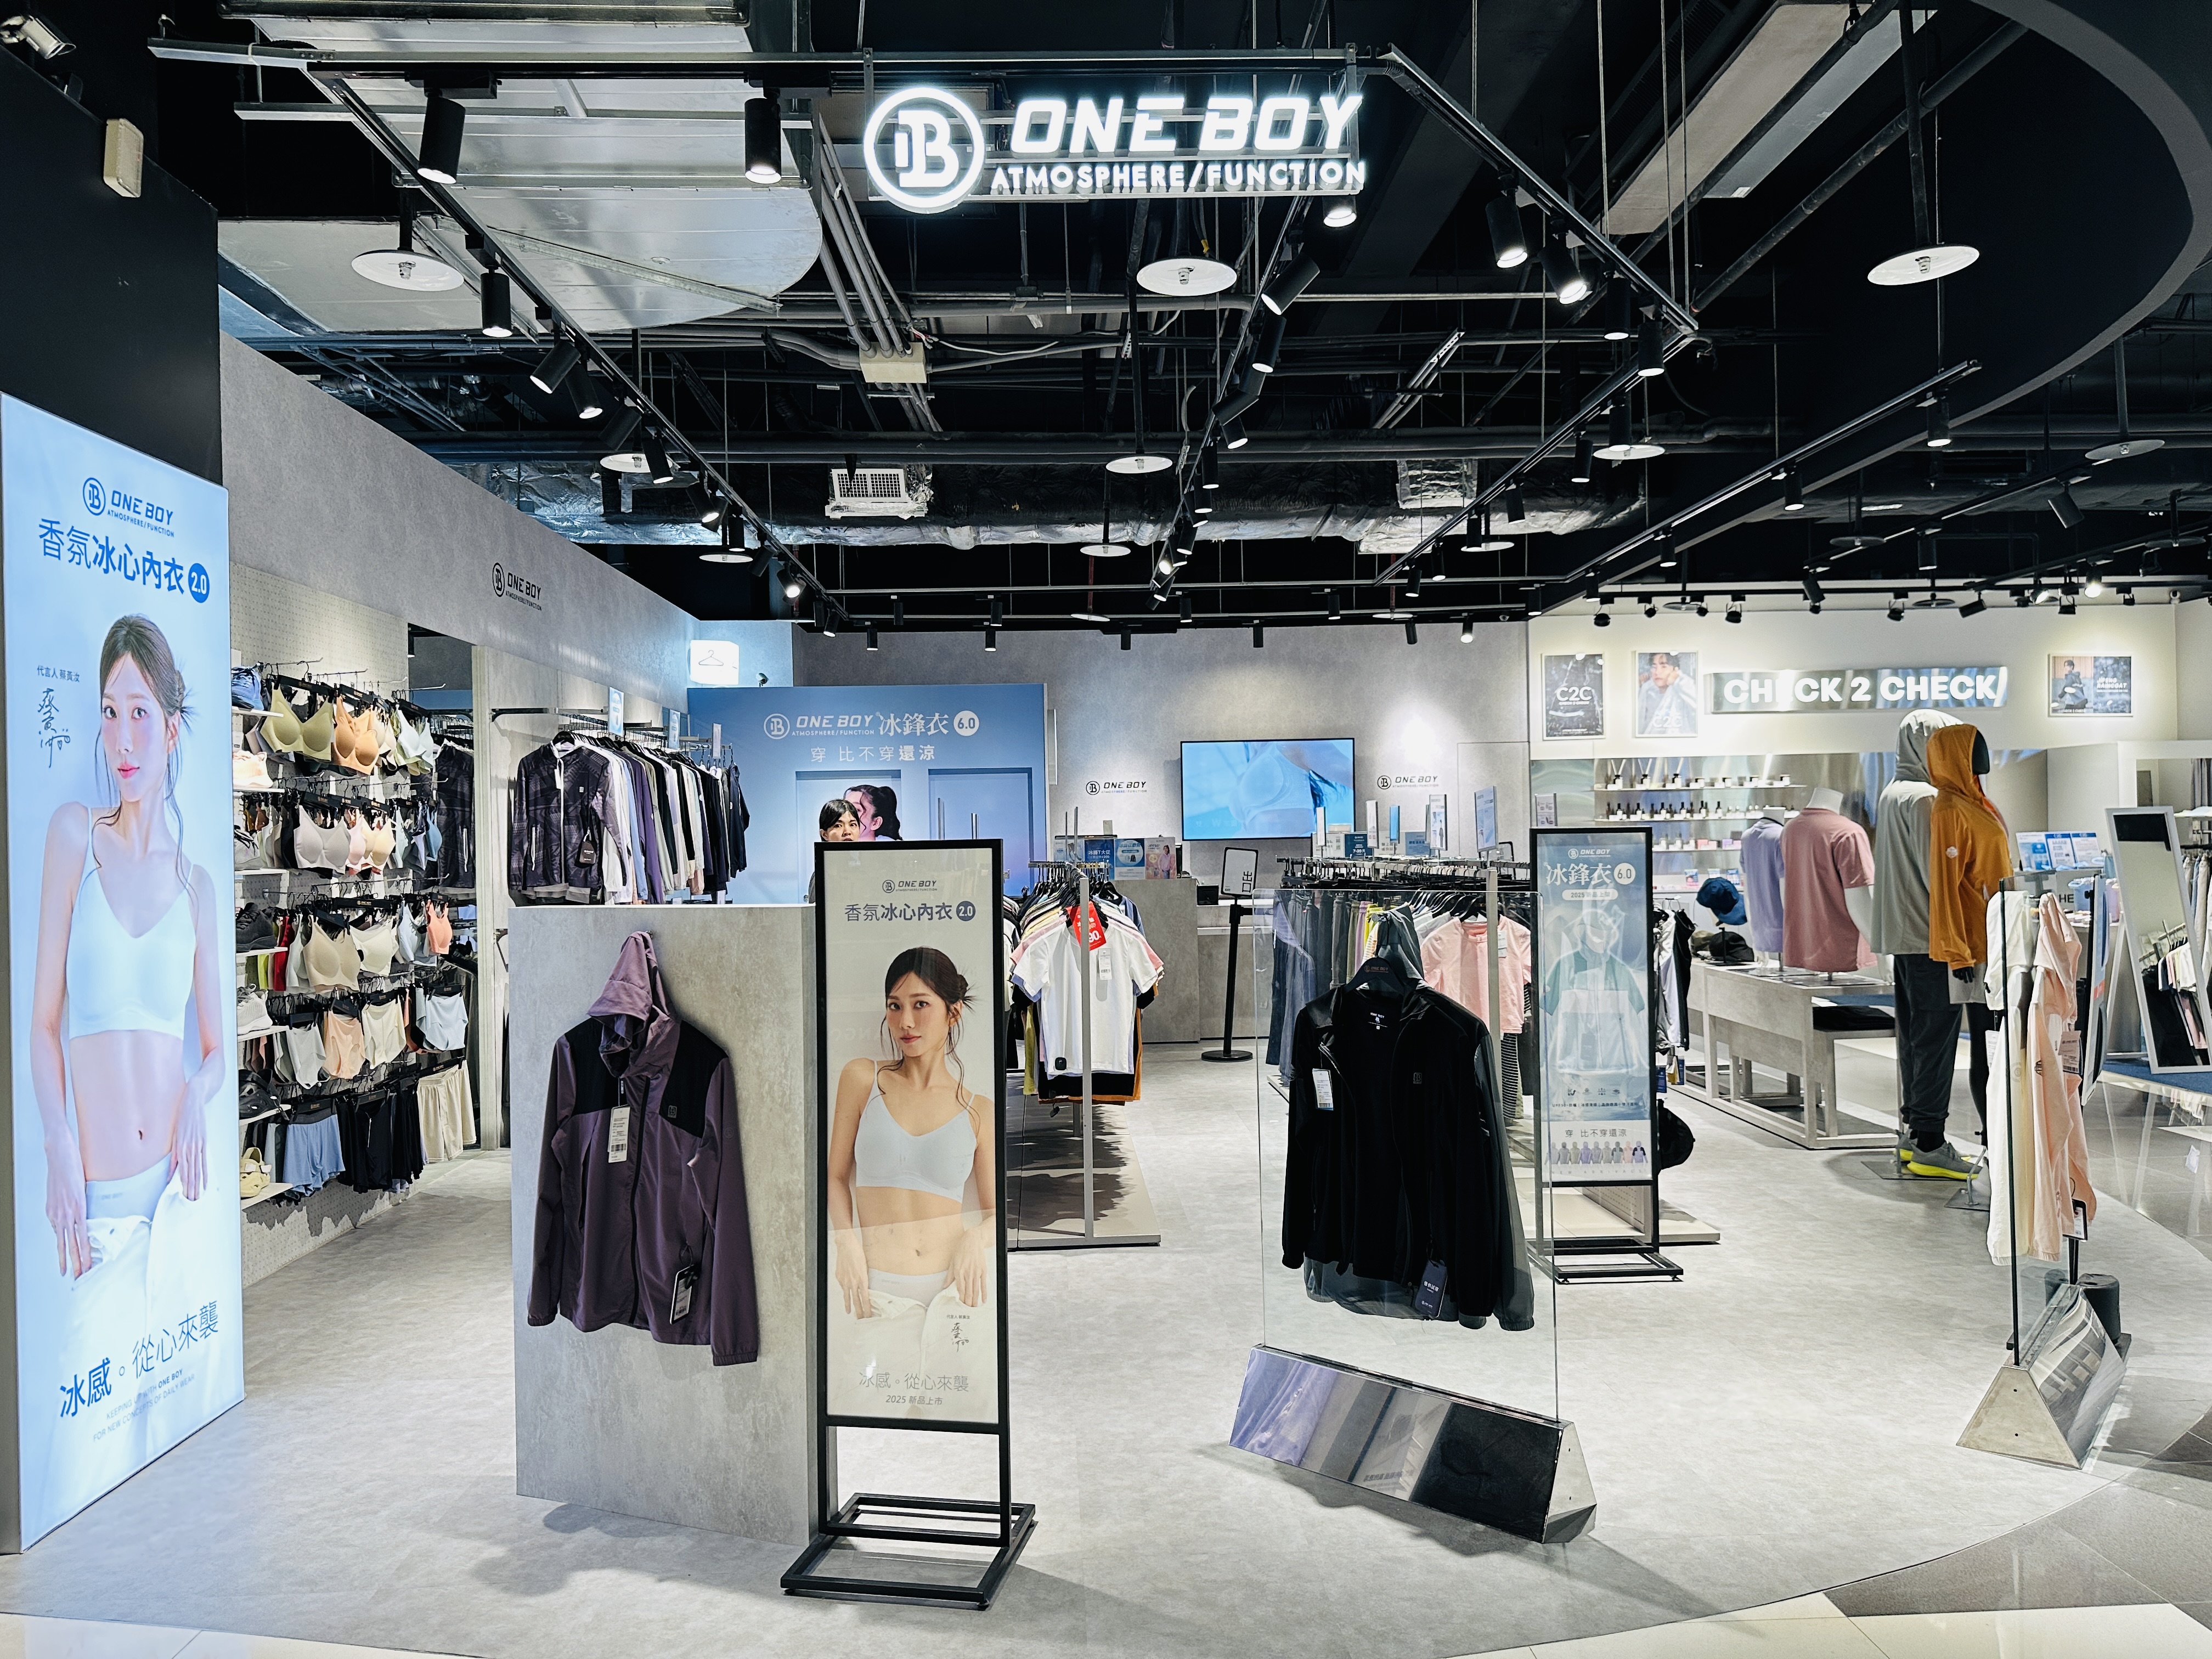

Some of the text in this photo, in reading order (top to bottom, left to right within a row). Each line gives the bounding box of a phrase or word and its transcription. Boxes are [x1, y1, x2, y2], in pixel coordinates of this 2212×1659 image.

[1011, 95, 1363, 154] ONE BOY
[990, 162, 1366, 189] ATMOSPHERE/FUNCTION
[111, 490, 173, 526] ONE BOY
[107, 509, 174, 538] ATMOSPHERE/FUNCTION
[38, 518, 207, 595] 香氛冰心內衣 2.0
[507, 572, 541, 600] ONE BOY
[37, 665, 58, 679] 代言人
[1556, 686, 1592, 701] C2C
[1850, 676, 1871, 702] 2
[1880, 674, 1997, 702] CHECK
[796, 715, 874, 728] ONE BOY
[878, 713, 949, 737] 冰鋒衣
[957, 717, 975, 730] 6.0
[1652, 715, 1682, 728] C2C
[810, 744, 935, 763] 穿 比不穿還涼
[1242, 871, 1252, 893] 出口
[1546, 862, 1632, 886] 冰鋒衣 6.0
[845, 902, 974, 922] 香氛冰心內衣 2.0
[106, 1368, 183, 1420] KEEPING UP WITH ONE BOY
[885, 1395, 944, 1406] 2025 新品上市
[93, 1373, 195, 1442] FOR NEW CONCEPTS OF DAILY WEAR
